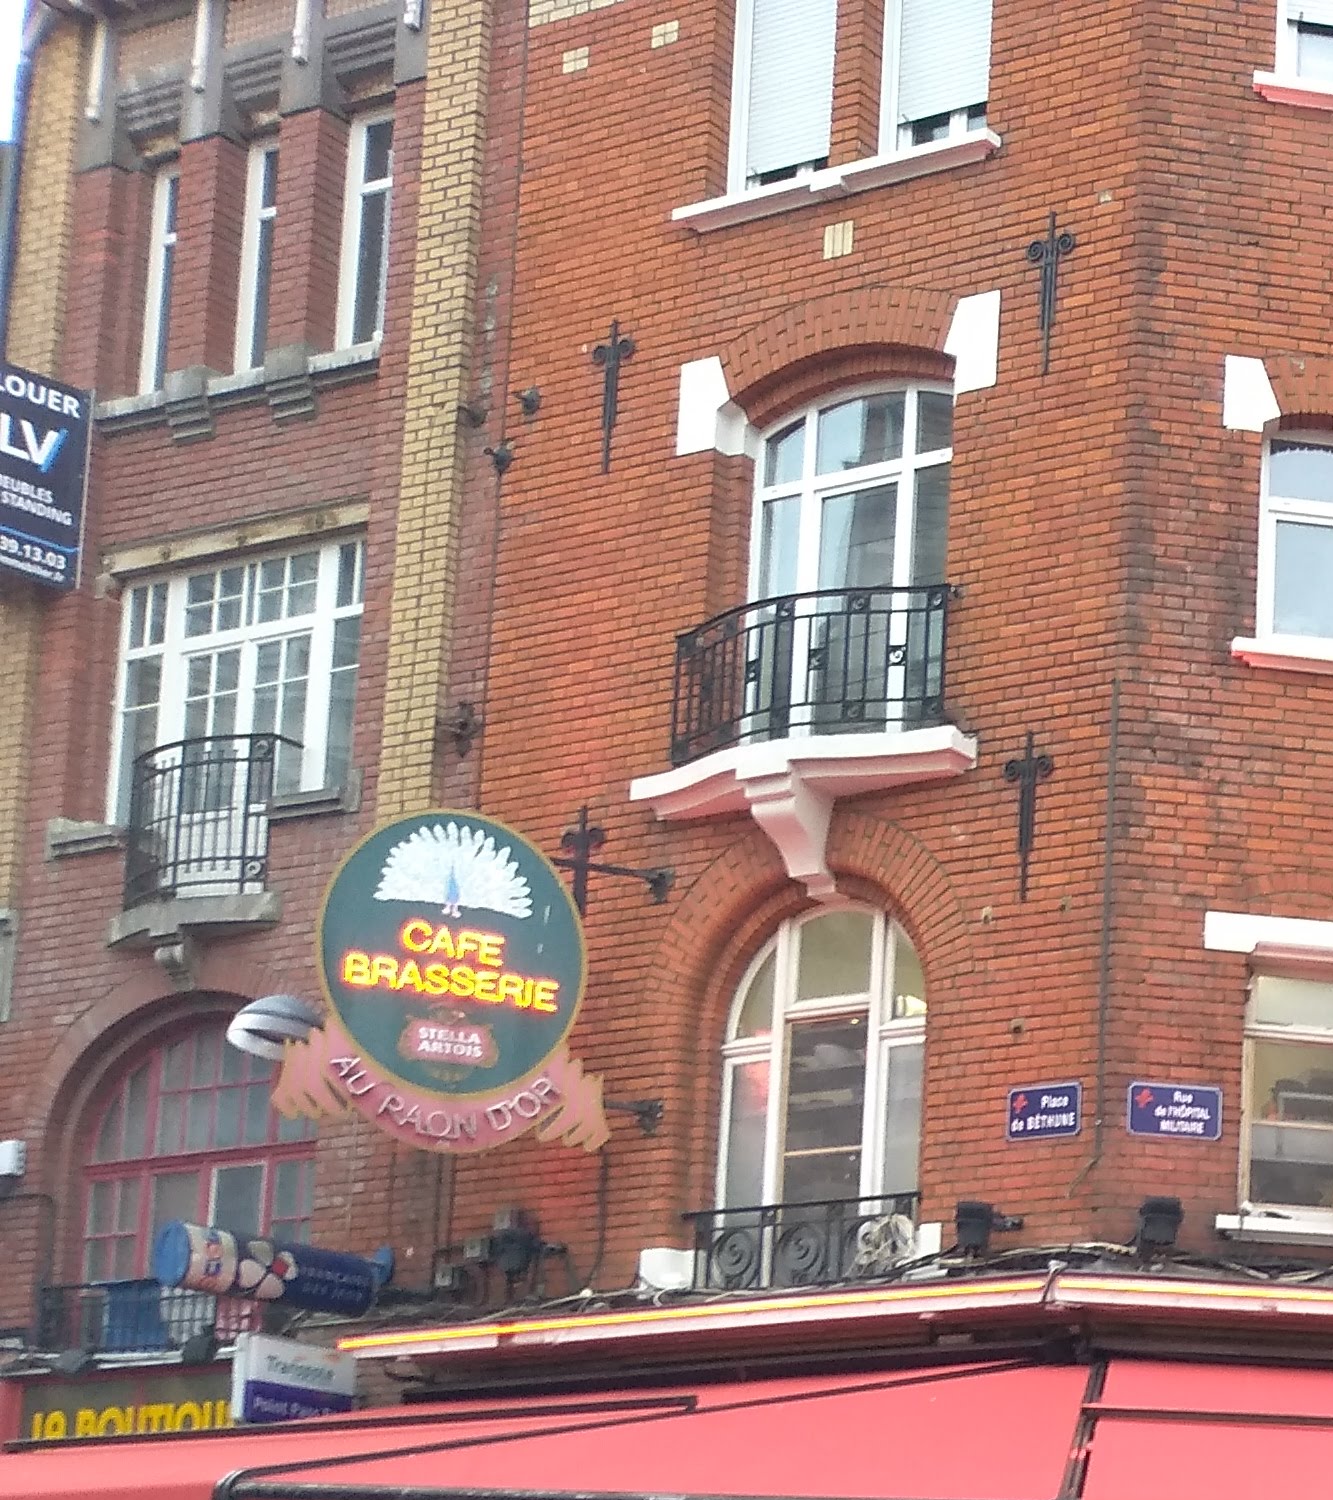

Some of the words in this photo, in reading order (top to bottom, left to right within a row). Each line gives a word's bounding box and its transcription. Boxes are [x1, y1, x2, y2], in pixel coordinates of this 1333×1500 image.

[401, 919, 506, 968] CAFE
[343, 951, 560, 1012] BRASSERIE
[418, 1026, 482, 1045] STELLA
[416, 1040, 484, 1059] ARTOIS
[329, 1055, 376, 1096] AU
[376, 1093, 479, 1140] PAON
[1040, 1094, 1070, 1110] Place
[1172, 1091, 1194, 1104] Rue
